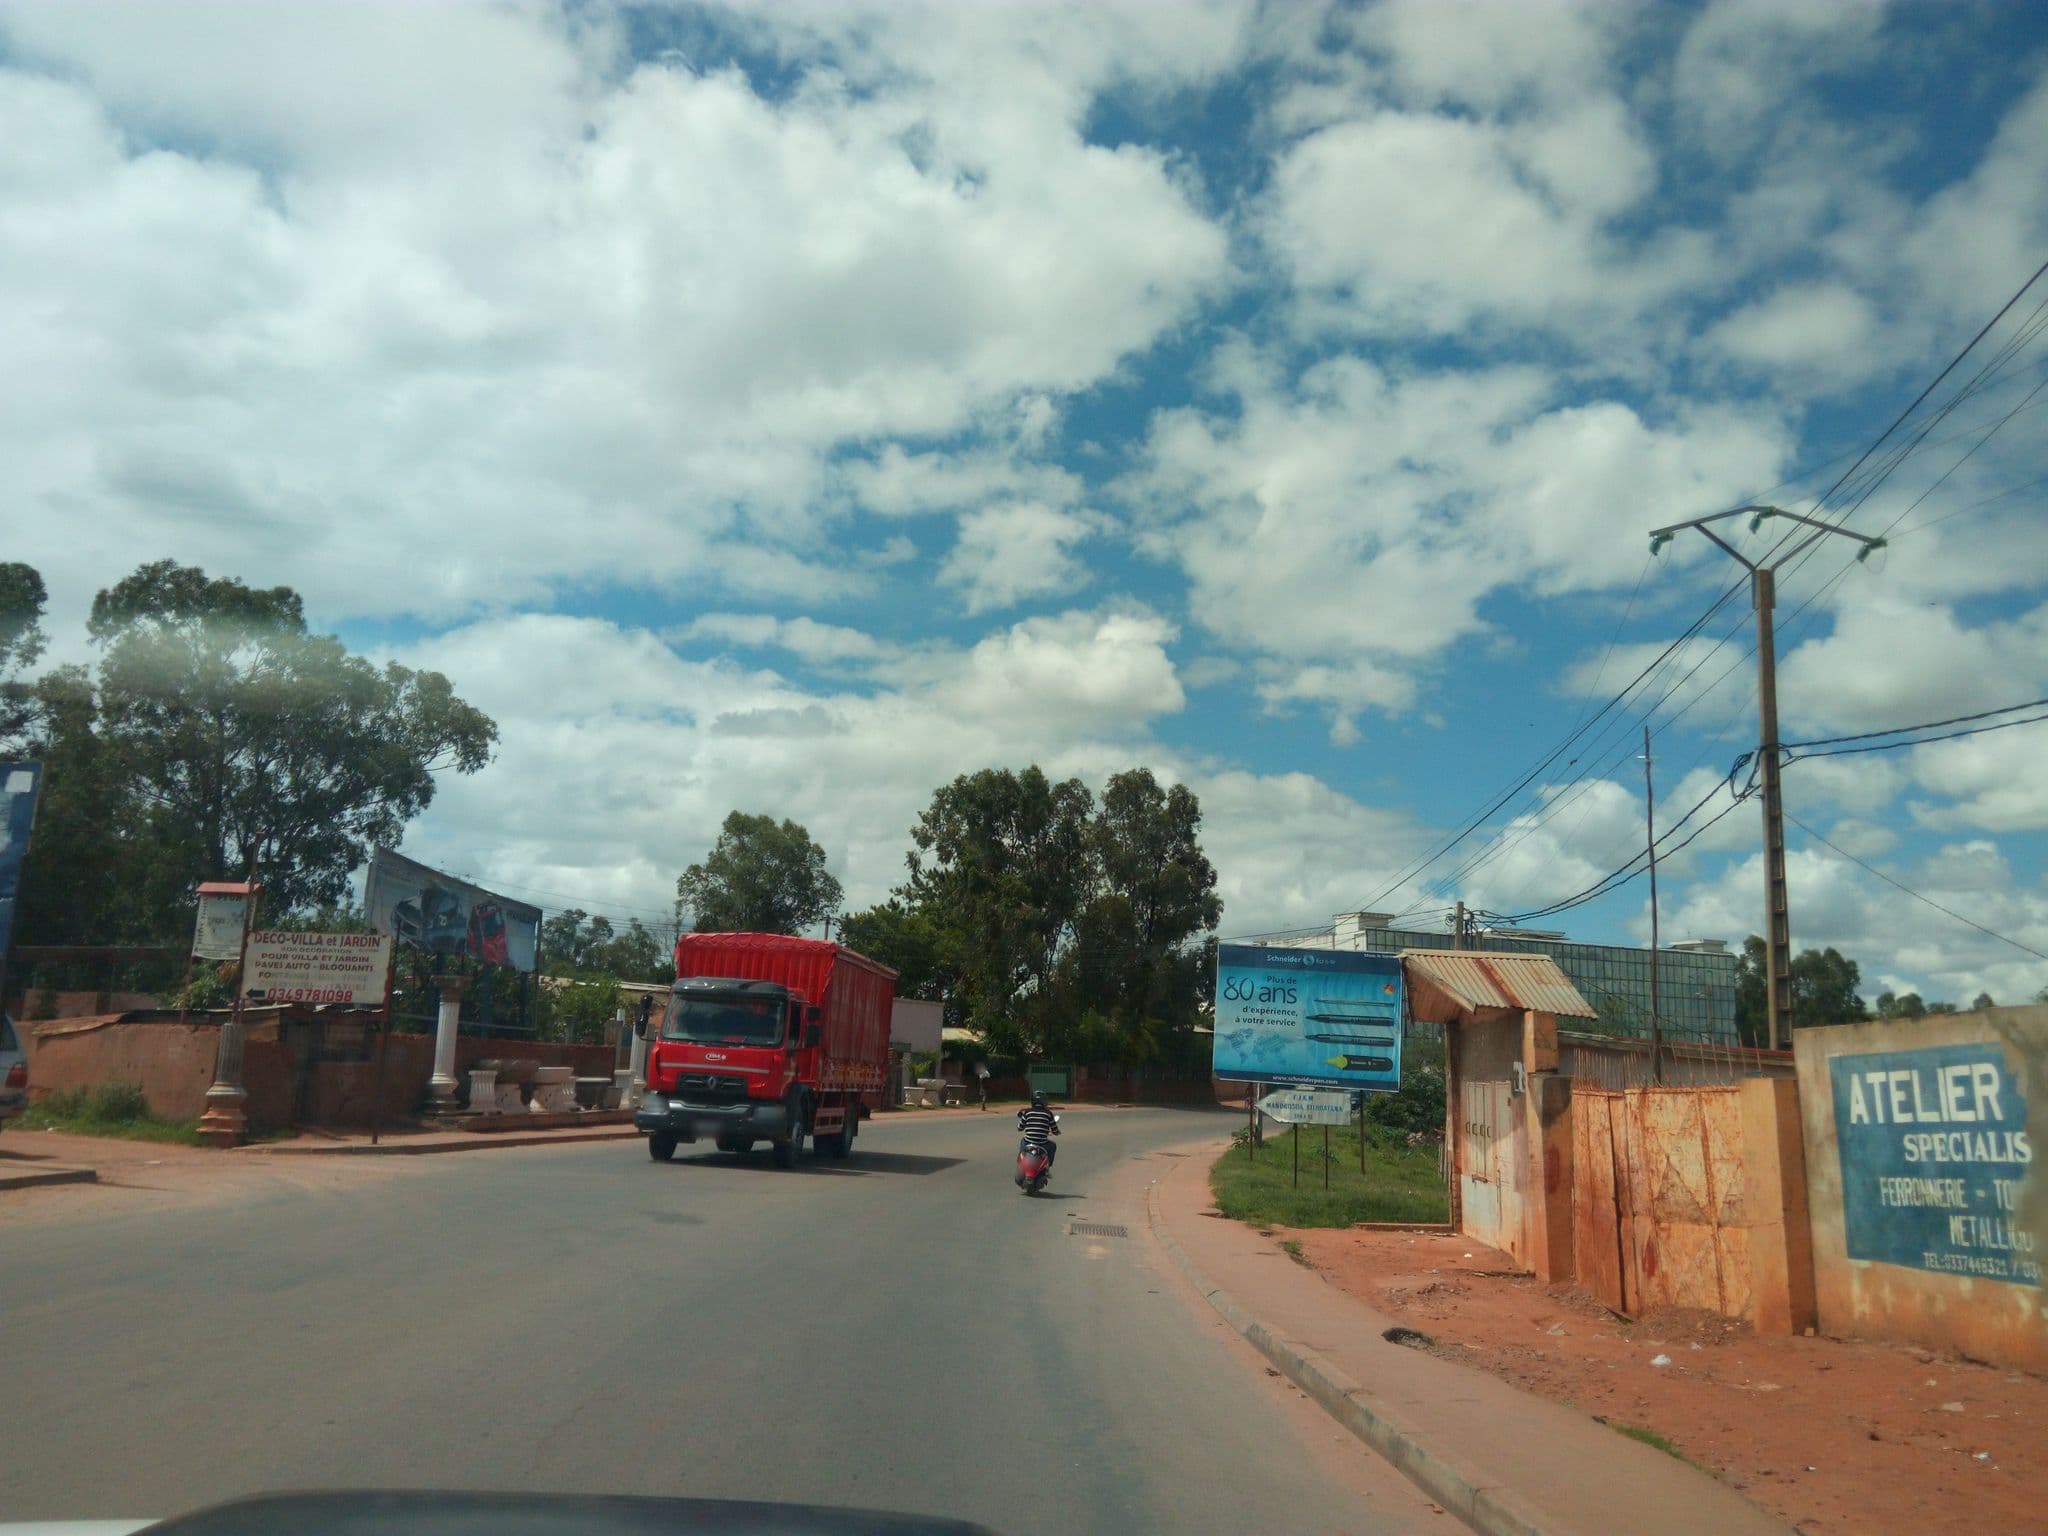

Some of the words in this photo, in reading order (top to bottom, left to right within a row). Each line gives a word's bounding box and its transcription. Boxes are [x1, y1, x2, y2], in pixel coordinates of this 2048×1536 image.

[326, 936, 337, 946] et
[261, 952, 289, 960] POUR
[321, 954, 333, 962] ET
[335, 955, 369, 963] JARDIN
[1266, 954, 1302, 963] Schneider
[284, 962, 311, 970] AUTO
[1266, 975, 1285, 984] Plus
[1286, 977, 1297, 985] de
[1223, 976, 1255, 1001] 80
[1258, 986, 1298, 1005] ans
[1242, 1005, 1299, 1018] d'expérience,
[1242, 1017, 1265, 1025] votre
[1267, 1018, 1297, 1027] service
[1272, 1075, 1339, 1086] www.schneiderpen.com
[1850, 1063, 2004, 1124] ATELIER
[1903, 1131, 2033, 1163] SPECIALIS
[1879, 1177, 1969, 1209] FERRONNERIE
